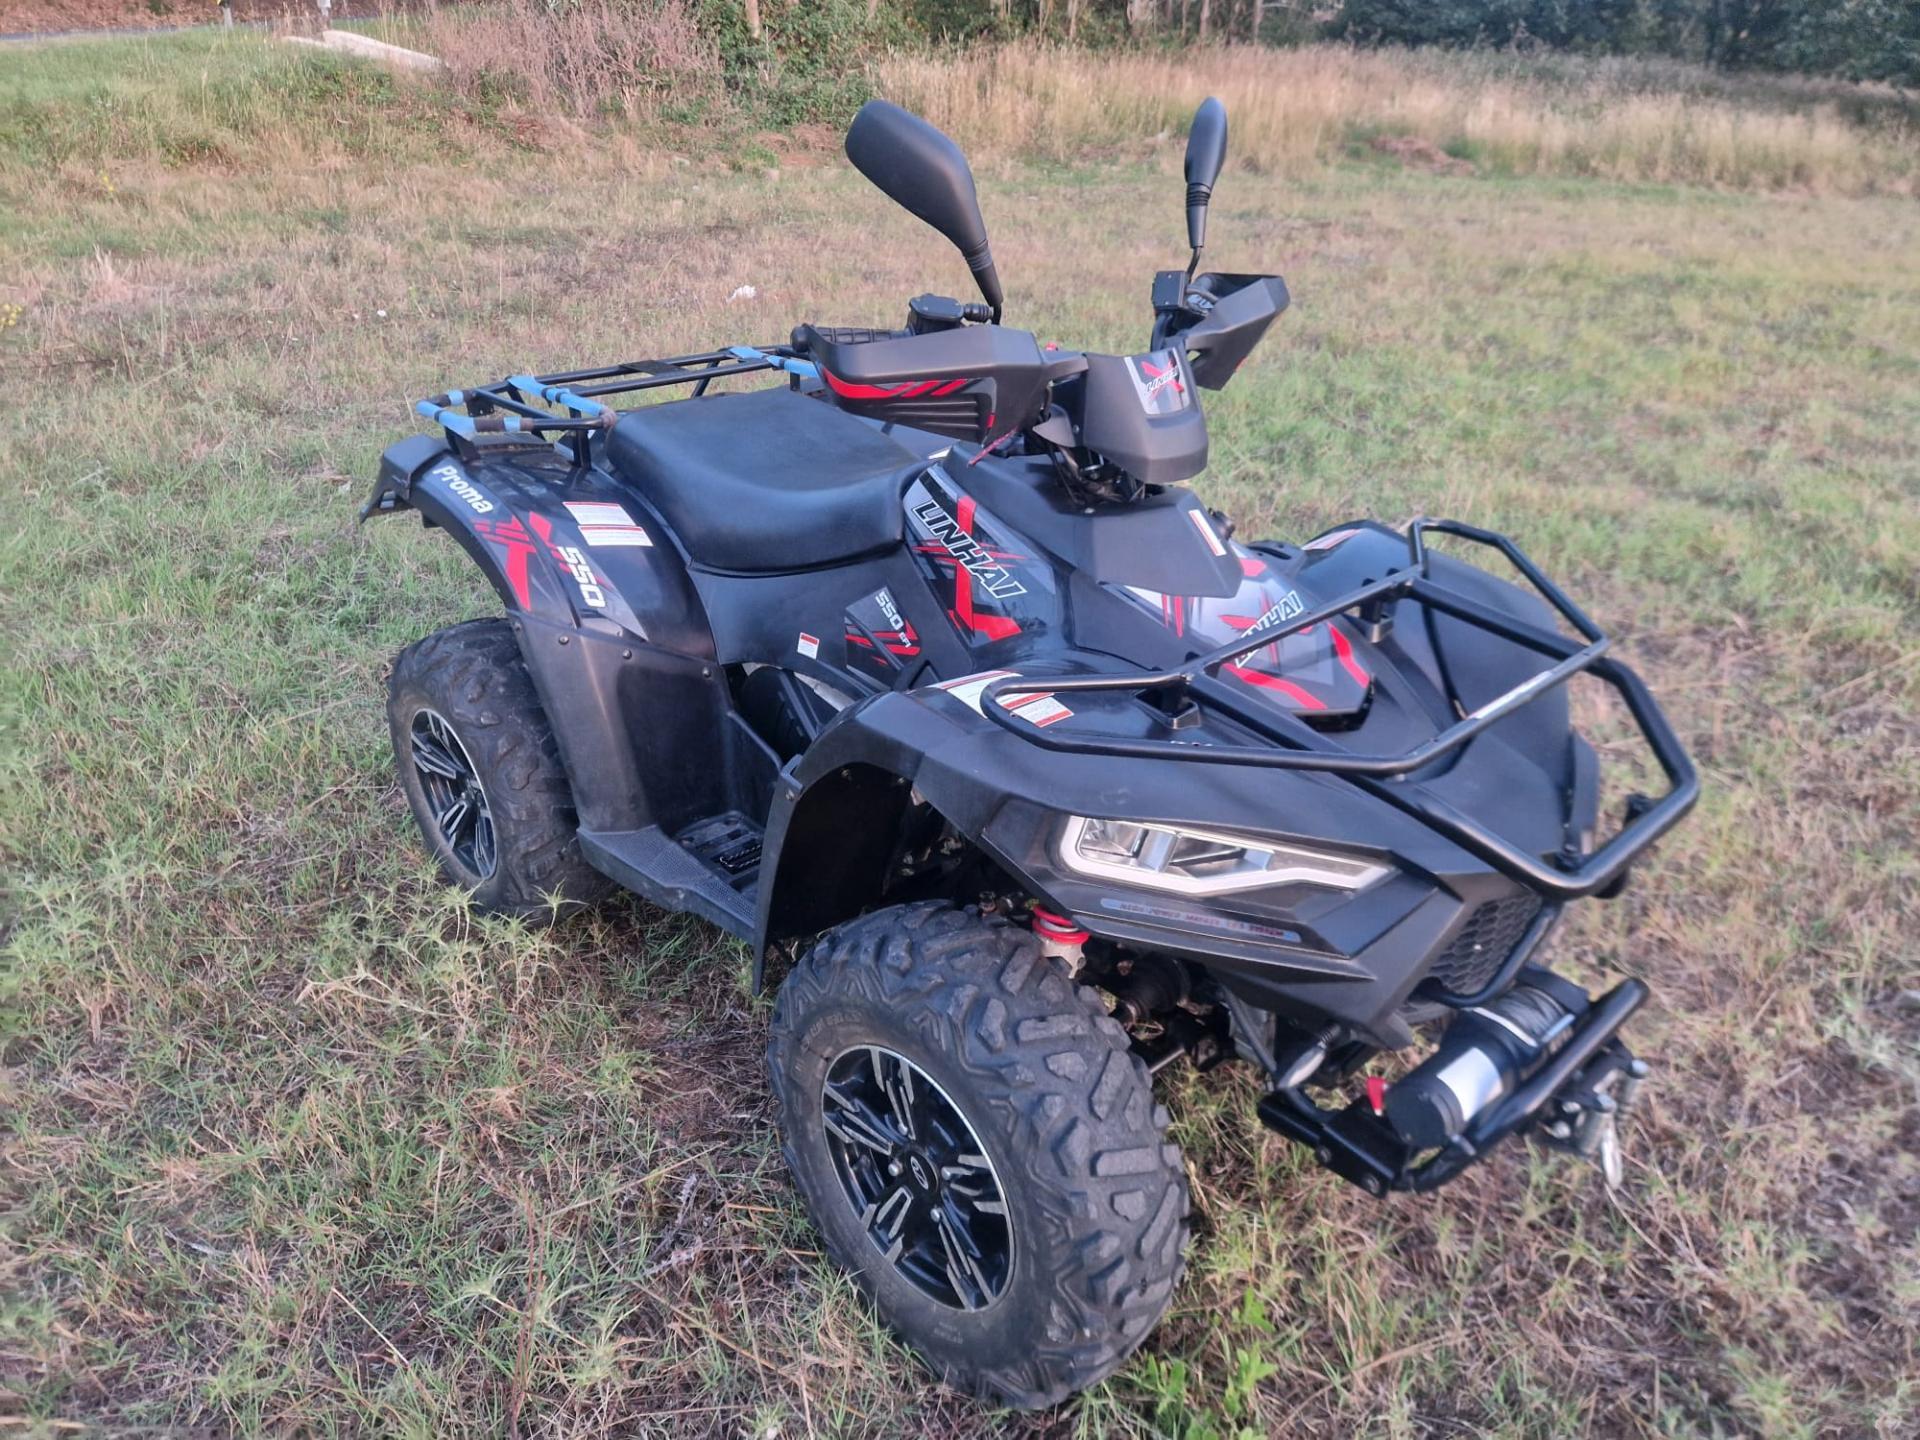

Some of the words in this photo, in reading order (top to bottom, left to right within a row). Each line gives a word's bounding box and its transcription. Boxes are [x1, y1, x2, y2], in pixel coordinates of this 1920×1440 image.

[433, 465, 494, 514] Proma
[912, 499, 1028, 599] LINHAI
[557, 546, 606, 608] 550
[875, 591, 904, 631] 550
